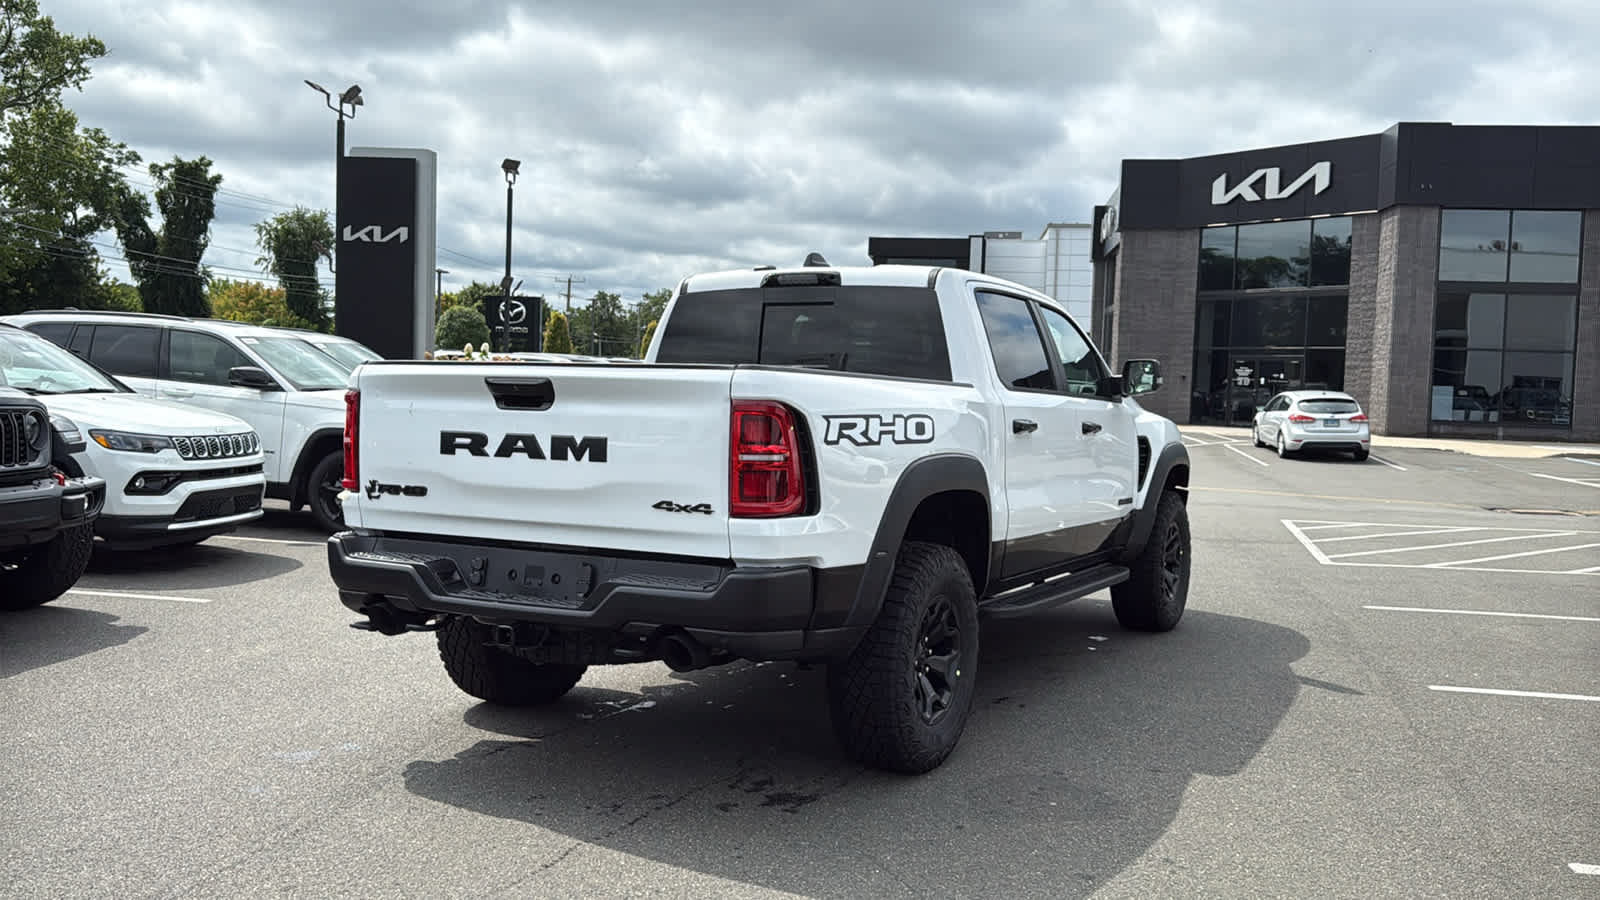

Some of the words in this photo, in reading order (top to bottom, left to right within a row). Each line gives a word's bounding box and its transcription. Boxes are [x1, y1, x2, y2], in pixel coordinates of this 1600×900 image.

[1212, 161, 1331, 205] KIA
[343, 224, 409, 244] KIA
[822, 414, 935, 446] RHO
[440, 430, 608, 463] RAM
[651, 500, 716, 515] 4x4
